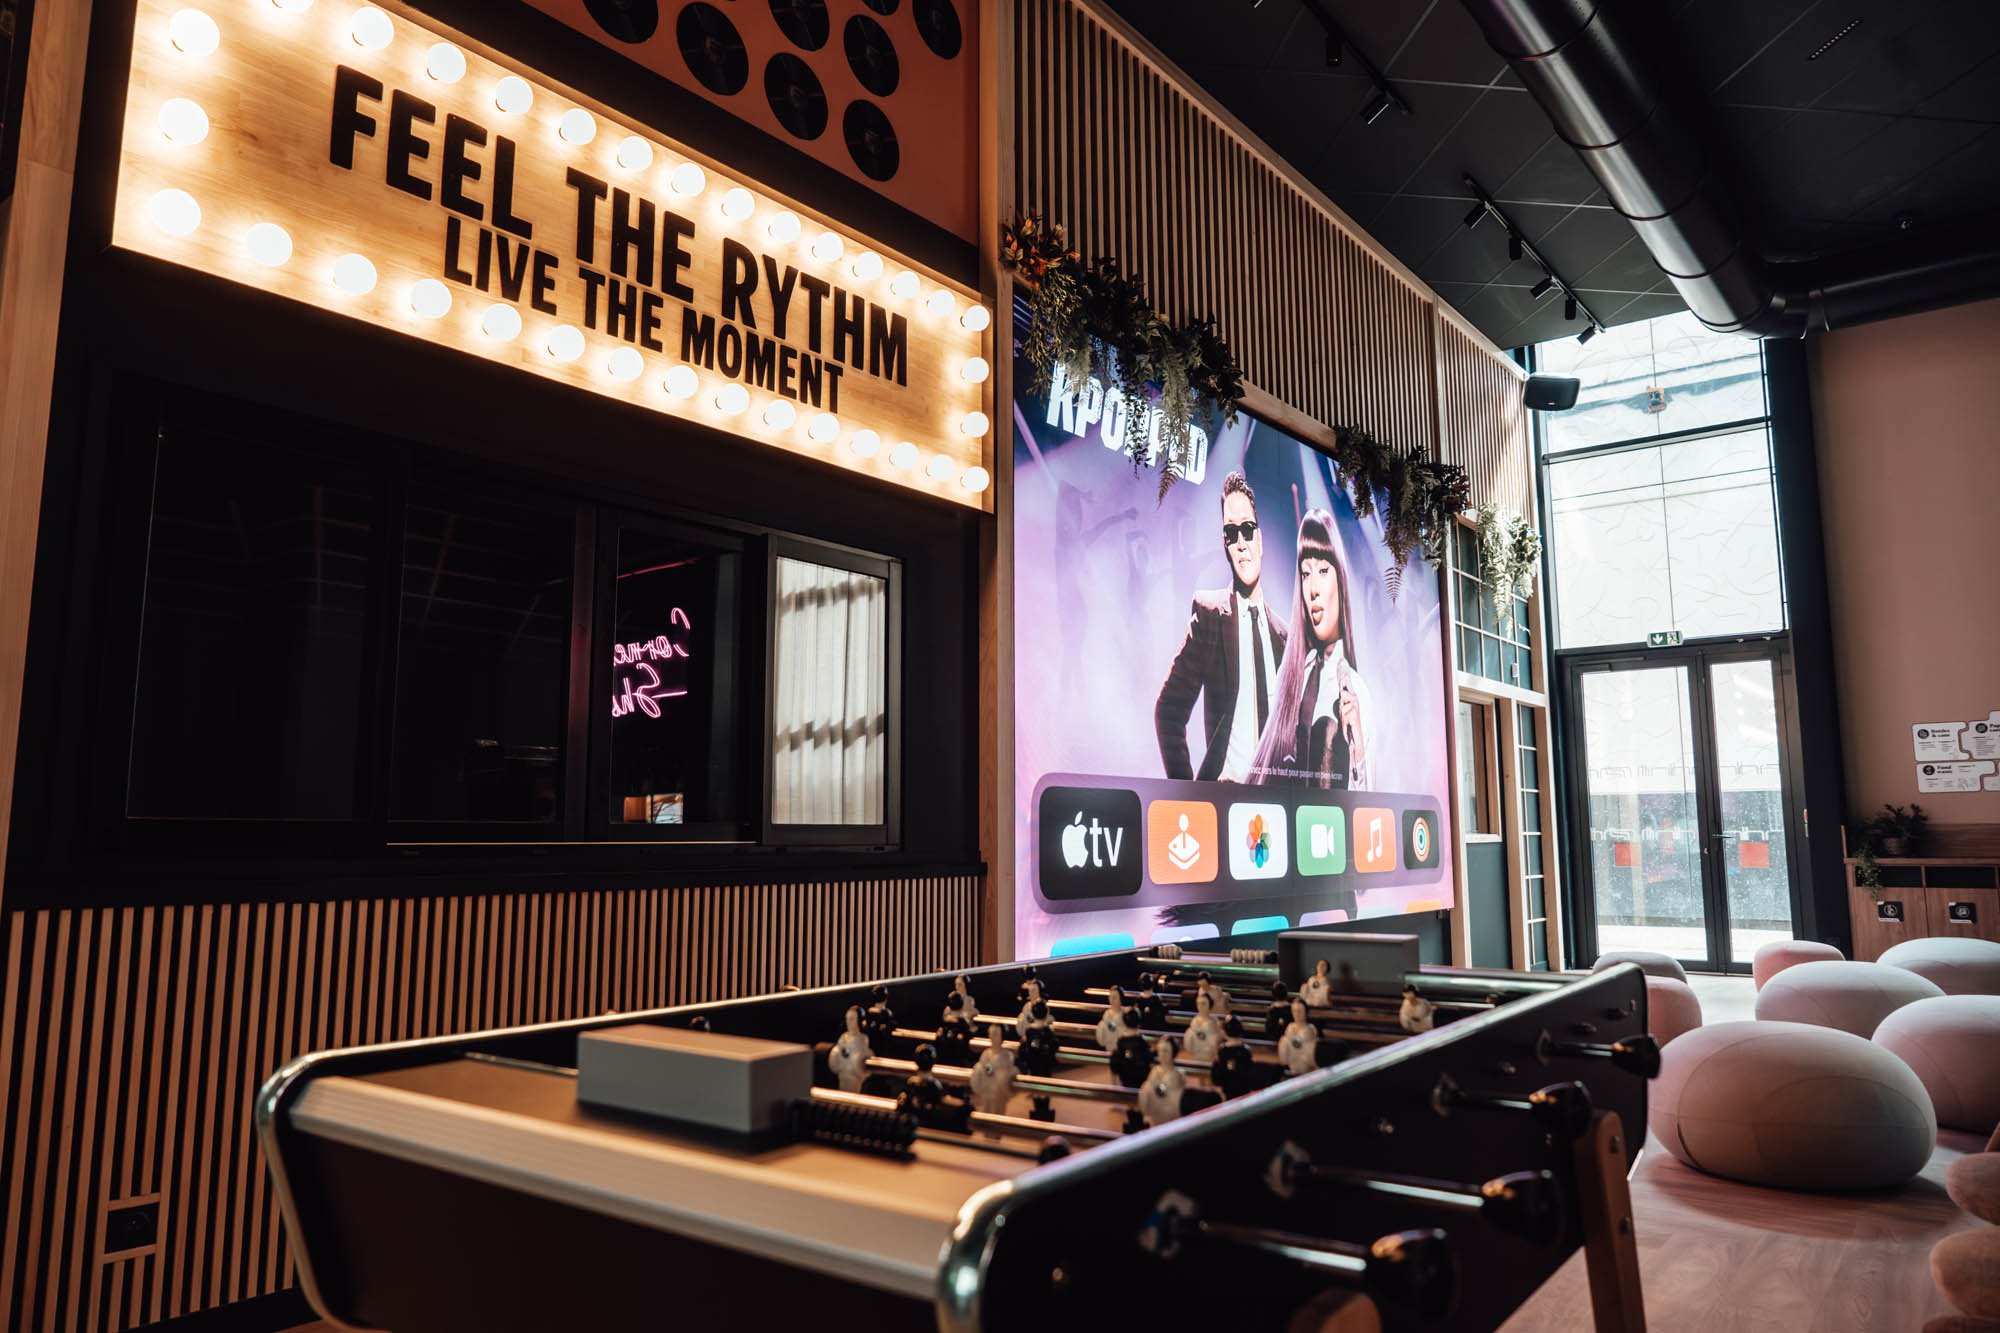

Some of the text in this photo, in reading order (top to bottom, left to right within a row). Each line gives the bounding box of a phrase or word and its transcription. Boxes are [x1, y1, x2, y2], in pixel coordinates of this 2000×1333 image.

[329, 64, 908, 387] FEEL THE RYTHM
[444, 215, 844, 414] LIVE THE MOMENT
[1089, 818, 1123, 867] tv
